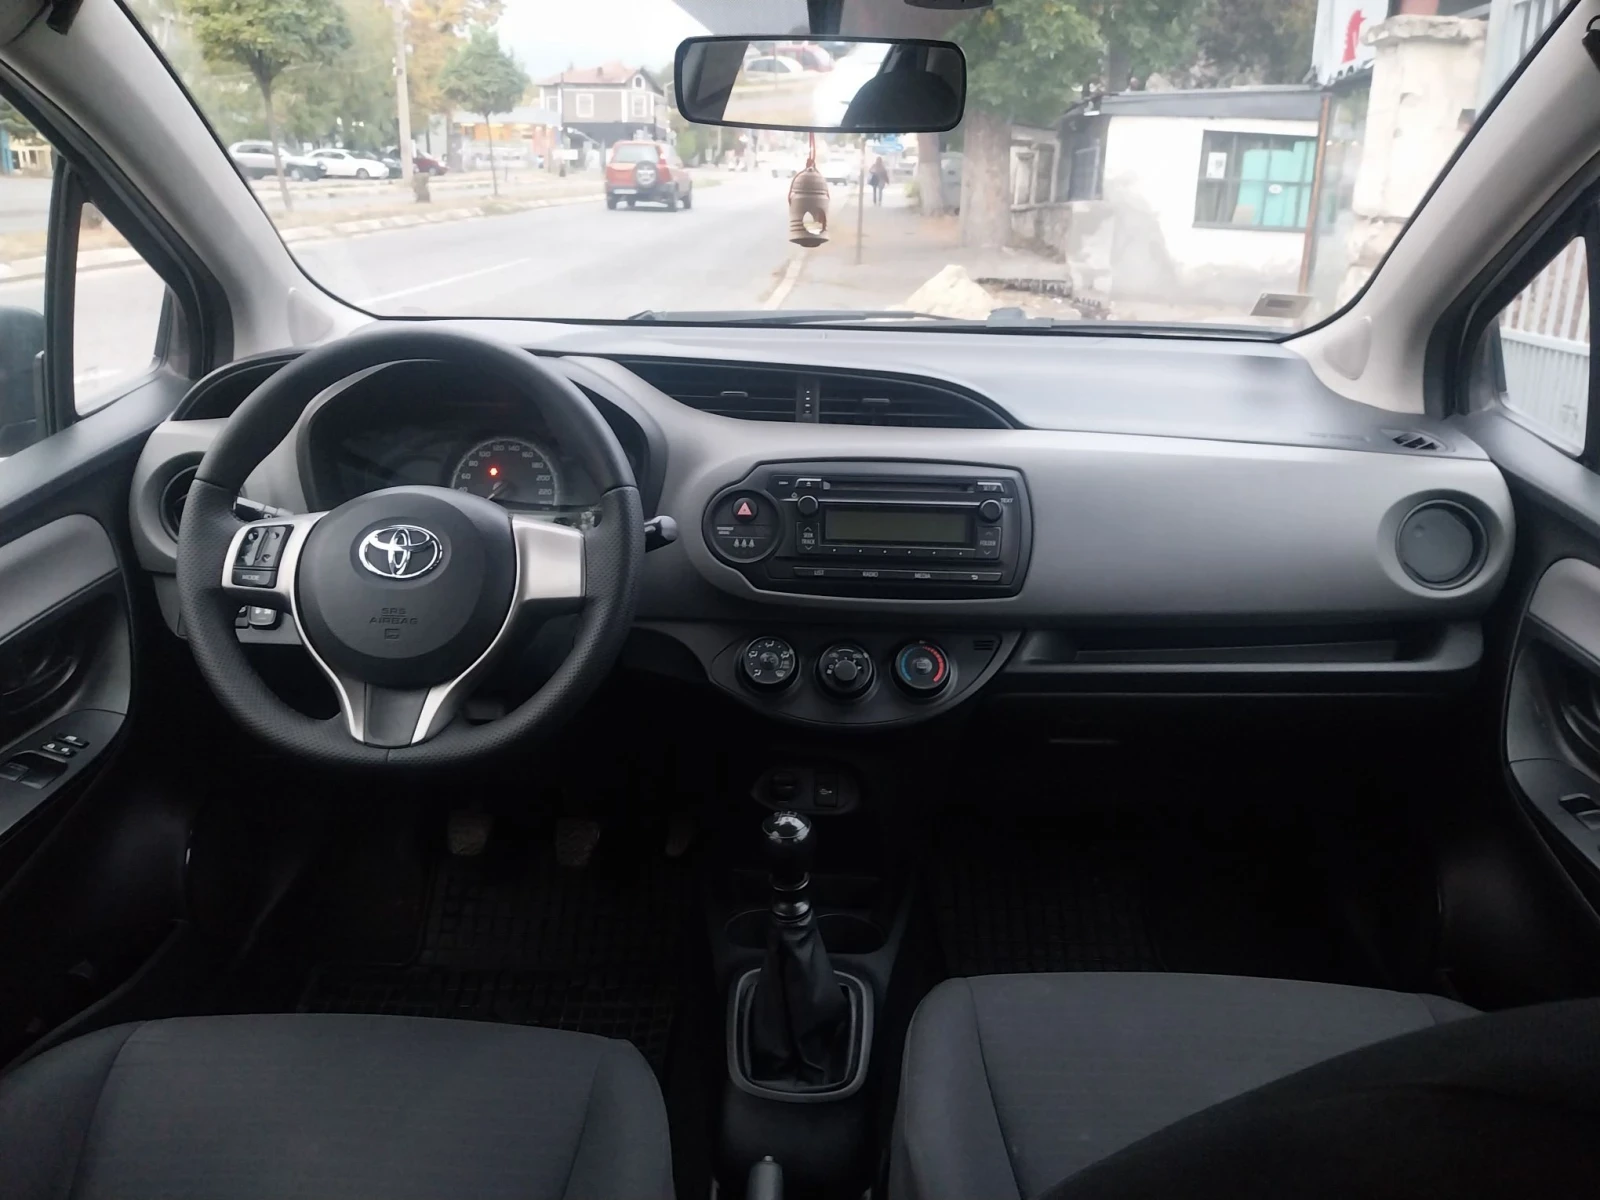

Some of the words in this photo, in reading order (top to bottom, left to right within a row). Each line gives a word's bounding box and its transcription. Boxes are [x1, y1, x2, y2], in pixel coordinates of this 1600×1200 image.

[493, 444, 505, 452] 120
[381, 607, 407, 615] SRS
[369, 617, 419, 625] AIRBAG
